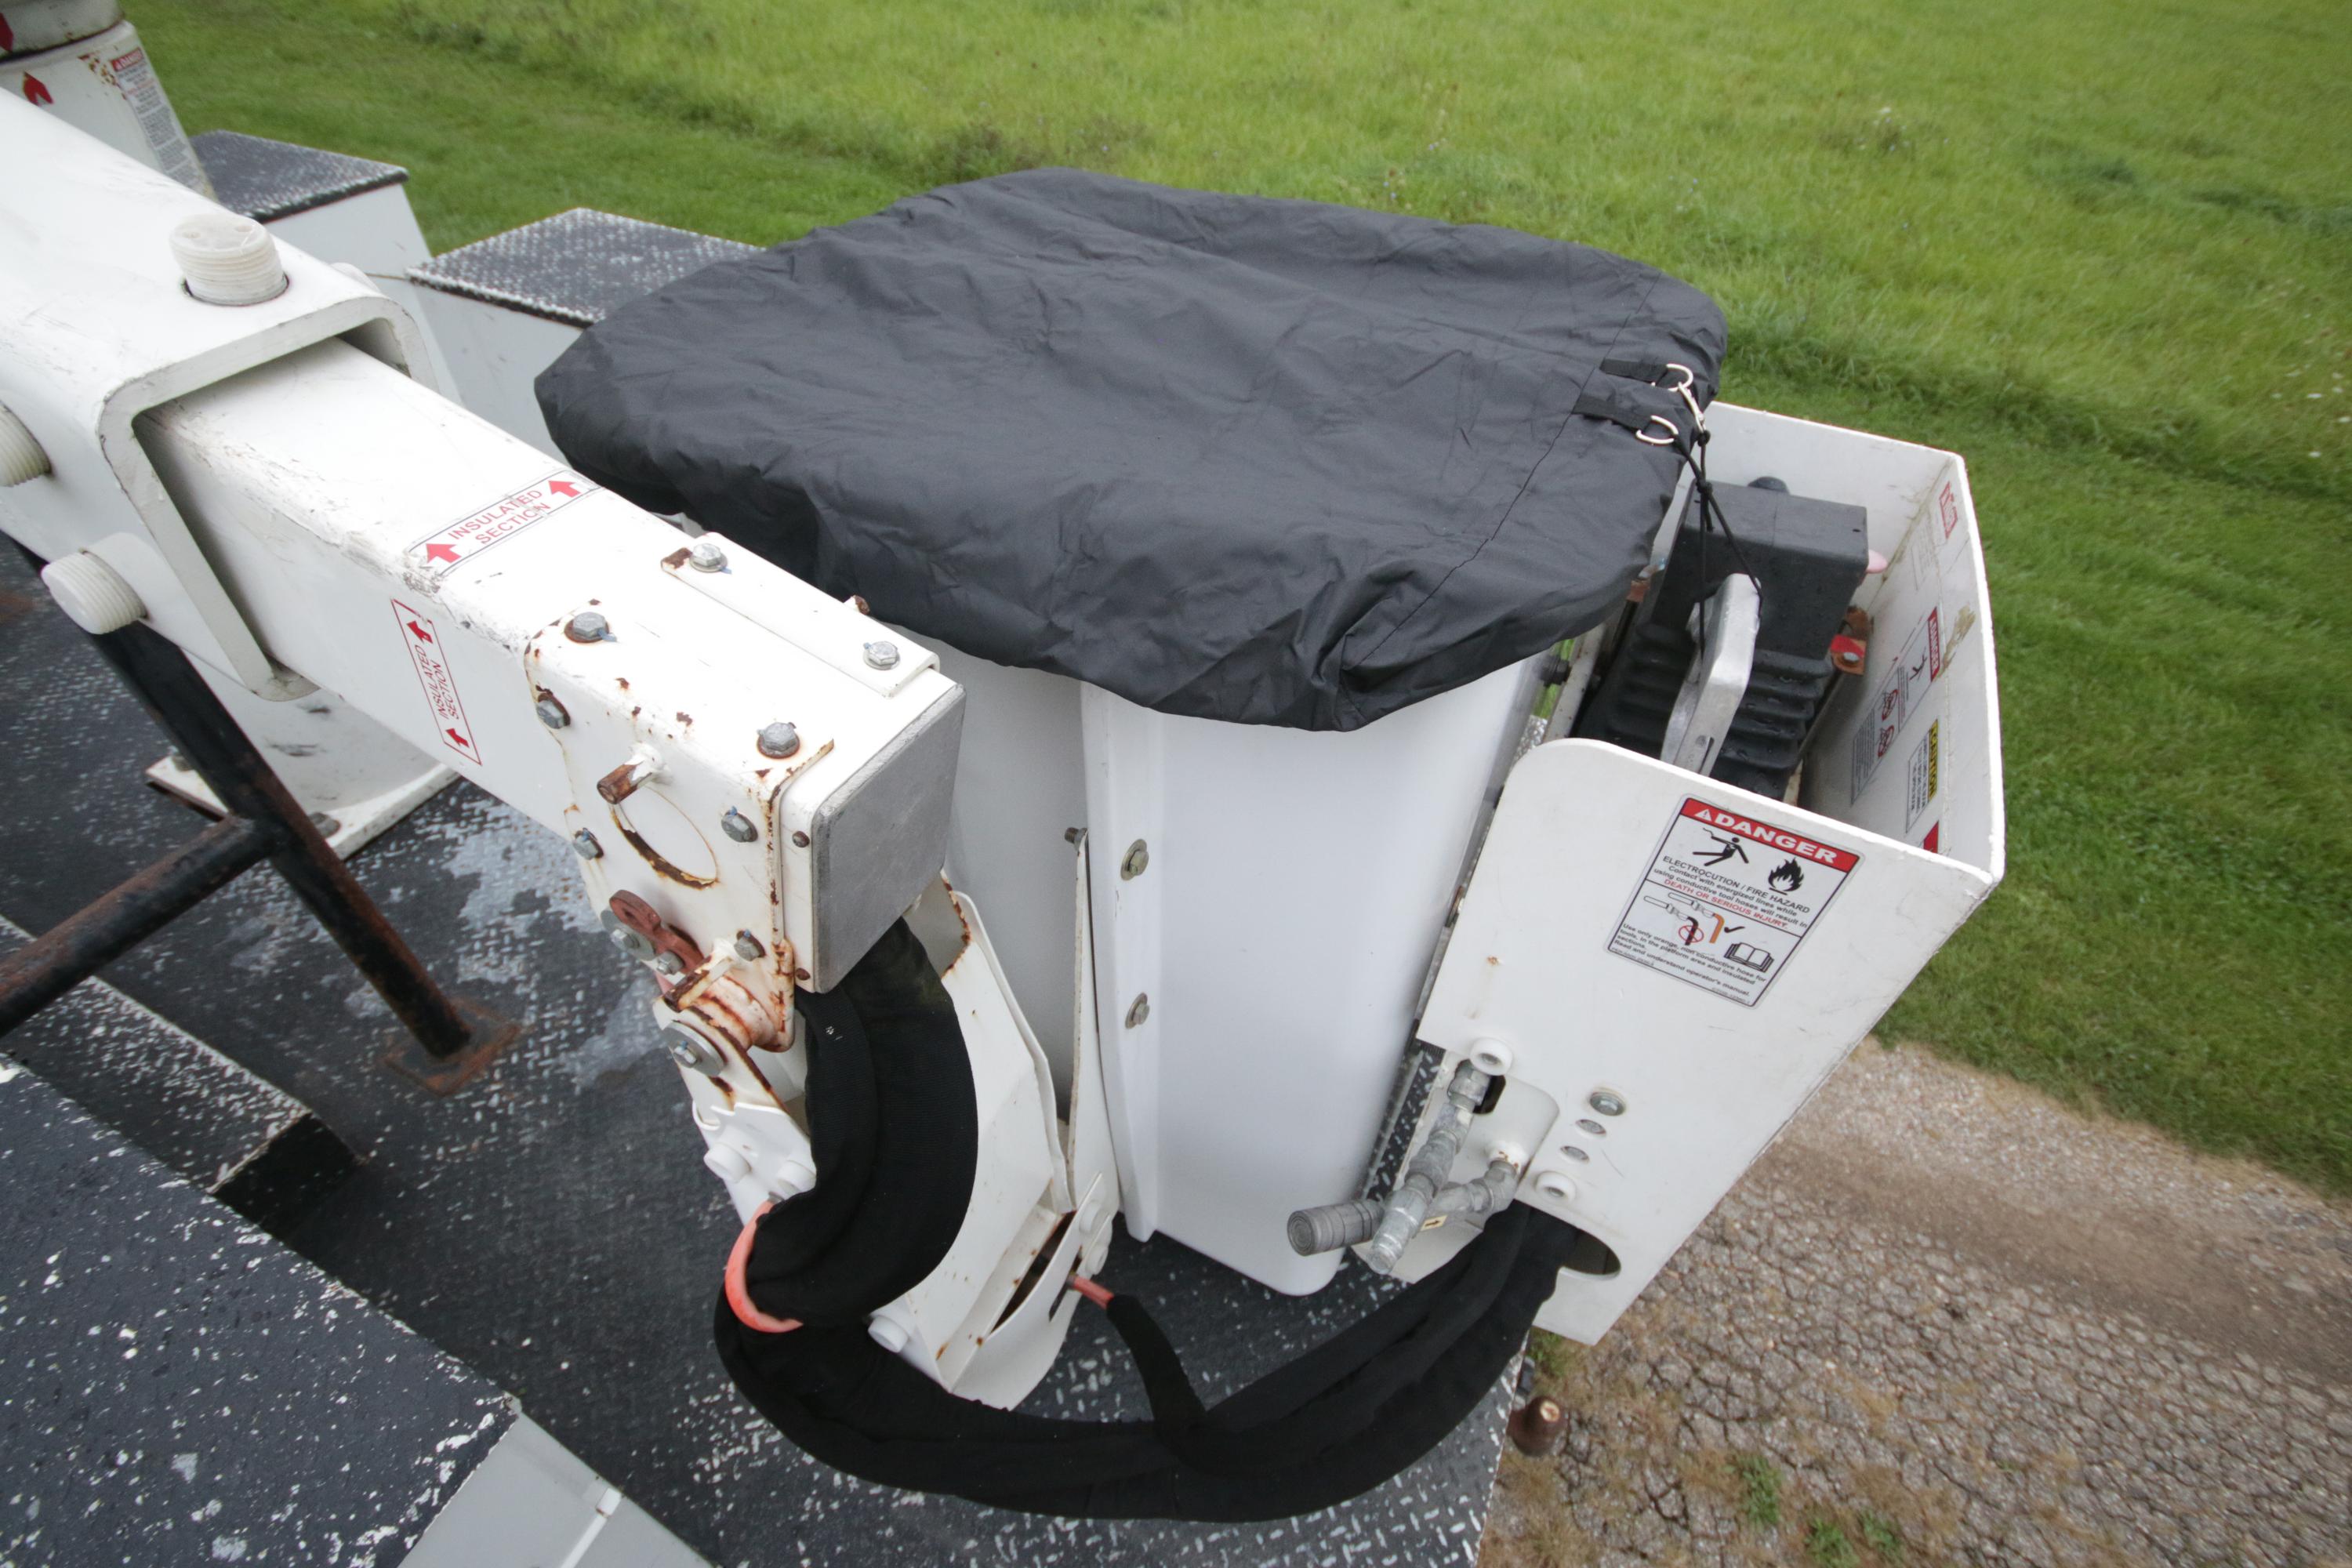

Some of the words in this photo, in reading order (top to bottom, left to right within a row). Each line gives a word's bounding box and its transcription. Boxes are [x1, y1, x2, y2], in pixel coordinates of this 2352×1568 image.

[448, 489, 543, 539] INSULATED
[475, 503, 551, 544] SECTION
[1929, 622, 1939, 675] DANGER
[415, 645, 448, 720] INSULATED
[433, 660, 459, 720] SECTION
[1929, 732, 1937, 798] CAUTION
[1713, 812, 1838, 863] DANGER
[1653, 869, 1675, 880] using
[1675, 877, 1718, 895] conductive
[1718, 892, 1734, 901] tool
[1734, 898, 1759, 909] hoses
[1759, 907, 1774, 916] will
[1775, 913, 1799, 924] result
[1662, 855, 1740, 887] ELECTROCUTION
[1745, 886, 1769, 898] FIRE
[1769, 895, 1811, 913] HAZARD
[1663, 879, 1694, 893] DEATH
[1695, 891, 1710, 899] OR
[1710, 896, 1752, 915] SERIOUS
[1752, 912, 1789, 928] INJURY.
[1668, 866, 1698, 880] Contact
[1698, 877, 1715, 886] with
[1715, 884, 1755, 901] energized
[1755, 898, 1775, 908] lines
[1775, 906, 1798, 916] while
[1613, 939, 1632, 949] Read
[1646, 953, 1686, 971] understand
[1686, 968, 1722, 985] operator's
[1617, 935, 1647, 949] sections.
[1652, 936, 1680, 949] orange,
[1736, 967, 1755, 977] hose
[1659, 945, 1690, 960] platform
[1721, 968, 1755, 985] insulated
